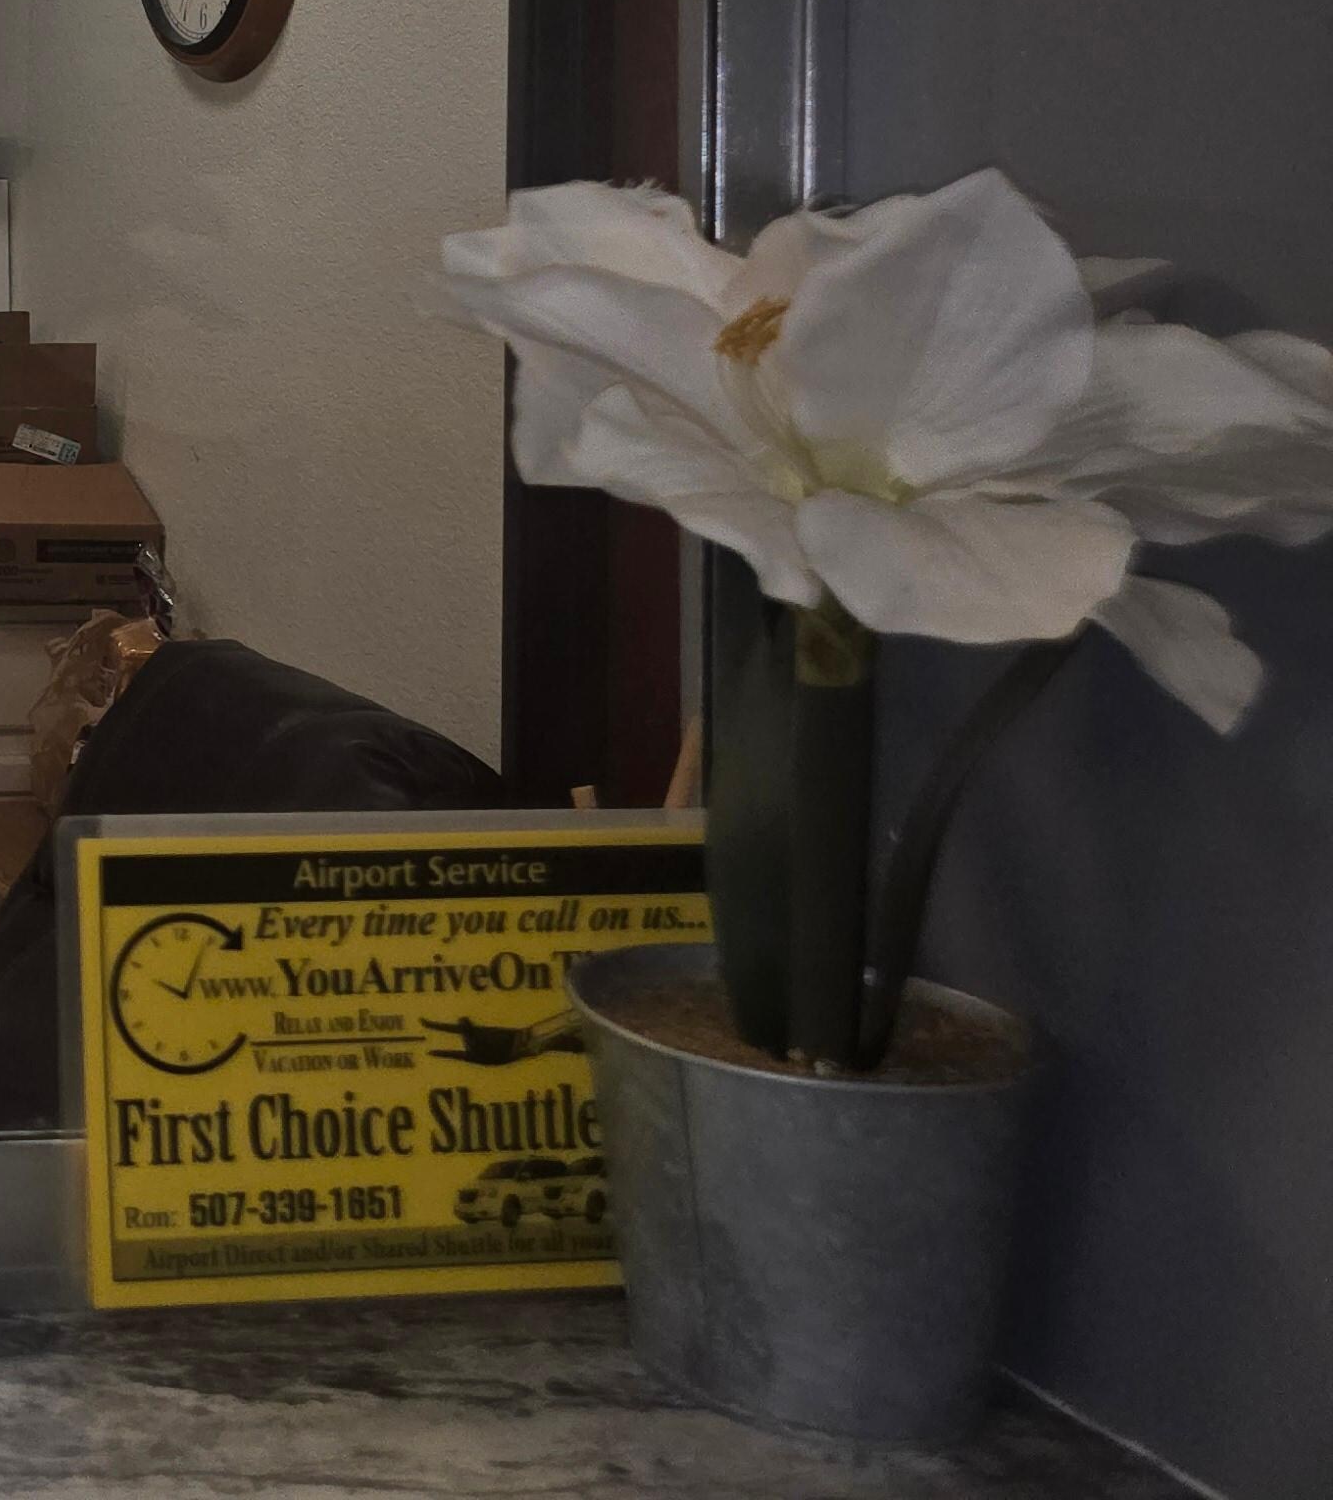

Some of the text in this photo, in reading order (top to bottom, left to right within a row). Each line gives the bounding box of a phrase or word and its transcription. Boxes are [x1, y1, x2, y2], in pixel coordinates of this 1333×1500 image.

[293, 855, 548, 897] Airport Service
[255, 900, 707, 945] Every time you call on us...
[114, 1083, 604, 1167] First Choice Shuttle
[189, 1185, 402, 1227] 507-339-1651
